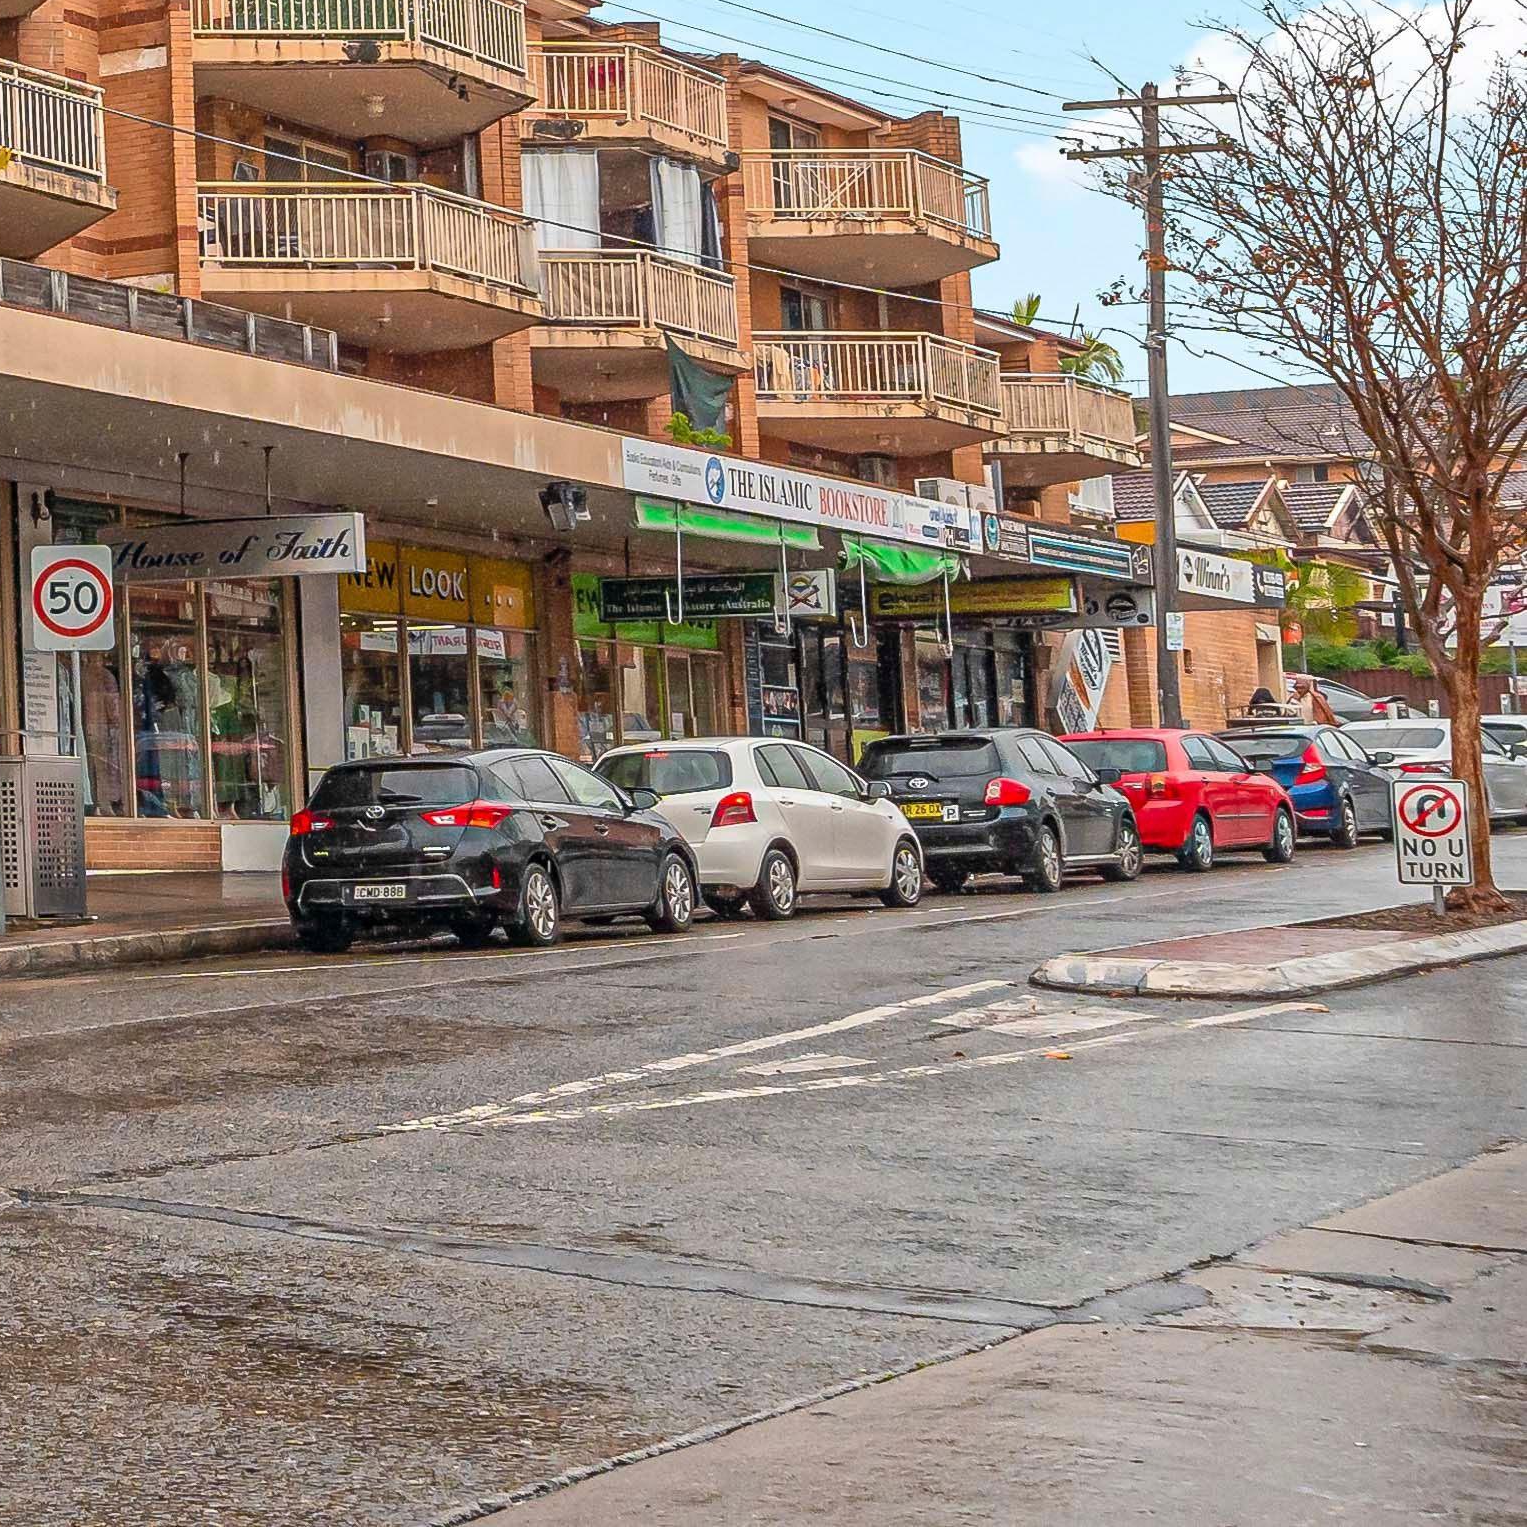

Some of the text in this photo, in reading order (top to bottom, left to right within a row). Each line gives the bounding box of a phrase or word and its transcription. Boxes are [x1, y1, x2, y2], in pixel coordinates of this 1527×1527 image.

[728, 468, 756, 500] THE
[759, 473, 813, 511] ISLAMIC
[818, 486, 889, 528] BOOKSTORE
[111, 528, 352, 570] House of Faith
[347, 558, 466, 602] NEW LOOK
[49, 580, 99, 616] 50
[606, 603, 623, 613] The
[627, 602, 662, 613] Islamic
[726, 599, 771, 611] Australia
[946, 808, 956, 819] P
[1402, 837, 1464, 858] NO U
[1406, 861, 1464, 879] TURN
